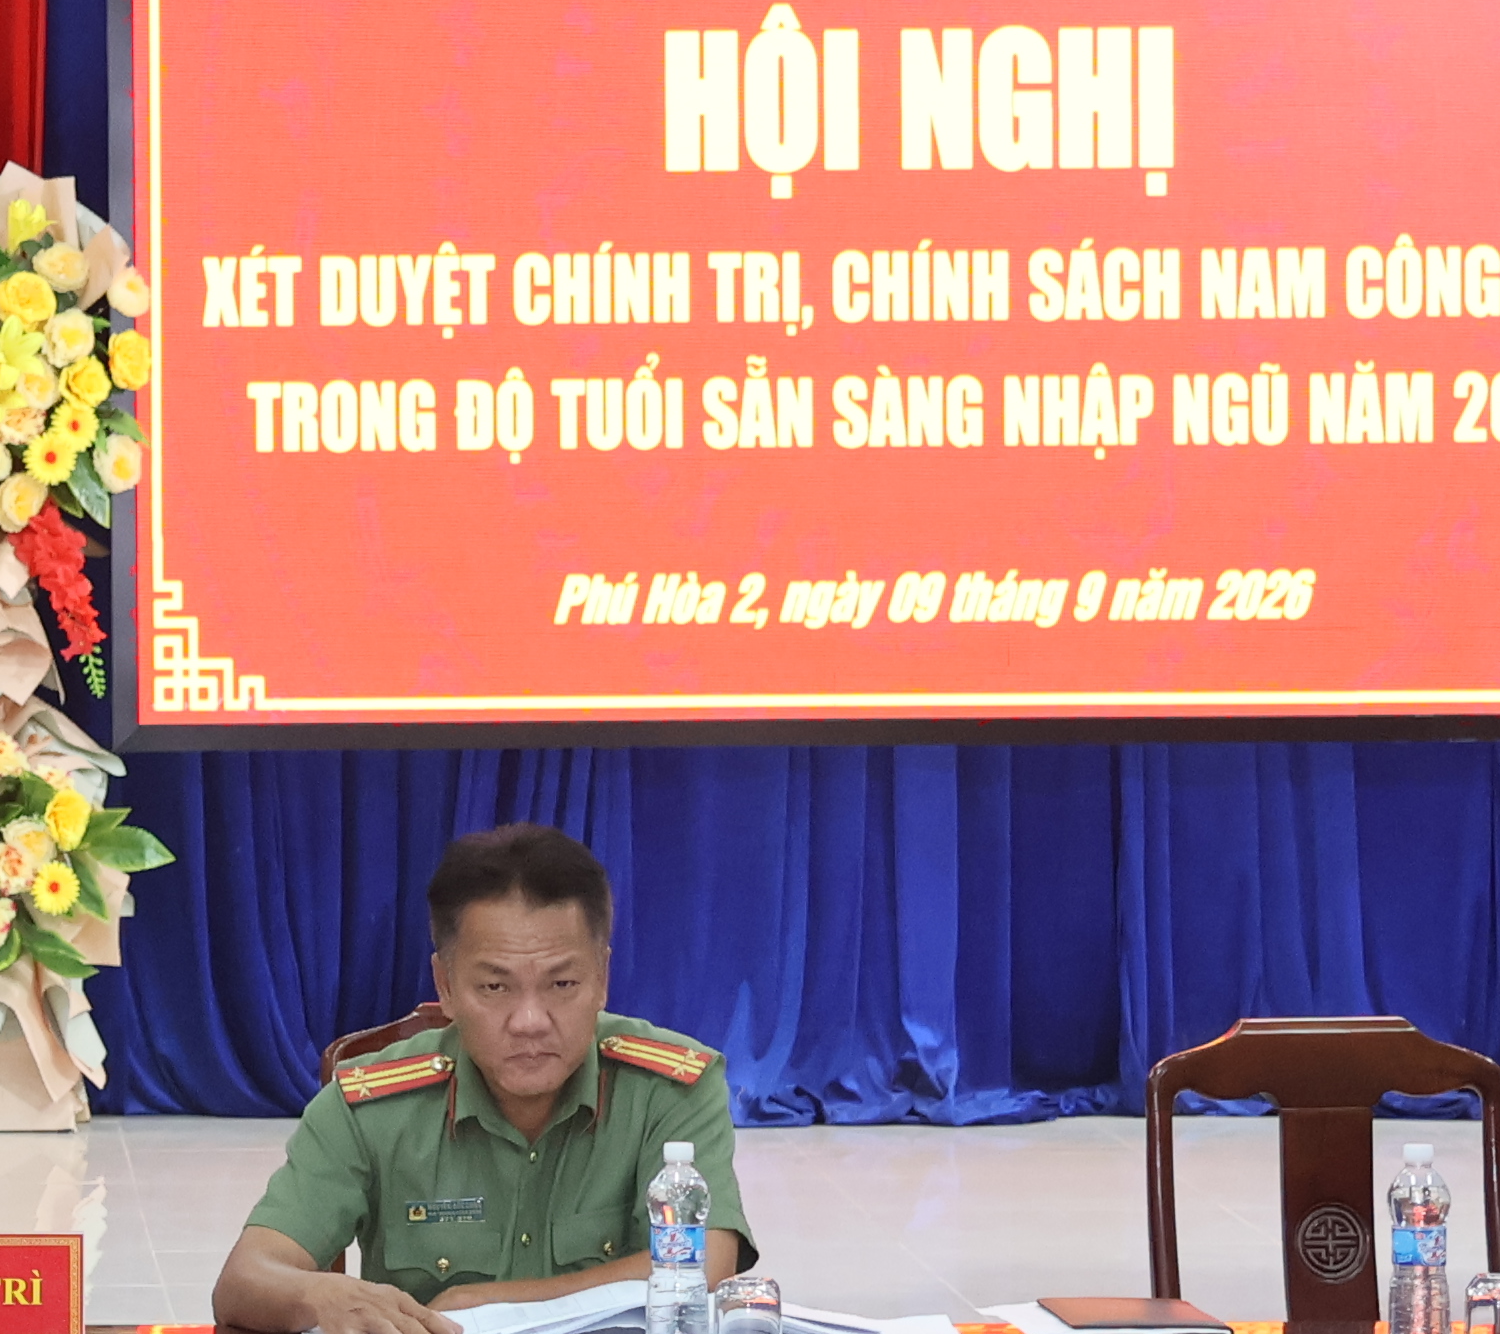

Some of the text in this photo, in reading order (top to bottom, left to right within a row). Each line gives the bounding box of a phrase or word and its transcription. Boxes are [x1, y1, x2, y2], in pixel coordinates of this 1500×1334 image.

[663, 2, 1176, 201] HỘI NGHỊ
[200, 243, 304, 329] XÉT
[318, 239, 498, 341] DUYỆT
[511, 239, 692, 327] CHÍNH
[706, 249, 816, 338] TRỊ,
[830, 237, 1011, 325] CHÍNH
[1026, 236, 1182, 324] SÁCH
[1199, 245, 1328, 321] NAM
[245, 377, 438, 455] TRONG
[452, 365, 536, 466] ĐỘ
[549, 351, 685, 453] TUỔI
[700, 353, 815, 452] SẴN
[830, 363, 985, 451] SÀNG
[1002, 360, 1156, 462] NHẬP
[1171, 360, 1290, 448] NGŨ
[1307, 359, 1436, 446] NĂM
[553, 567, 1318, 631] Phú Hòa 2, ngày 09 tháng 9 năm 2026
